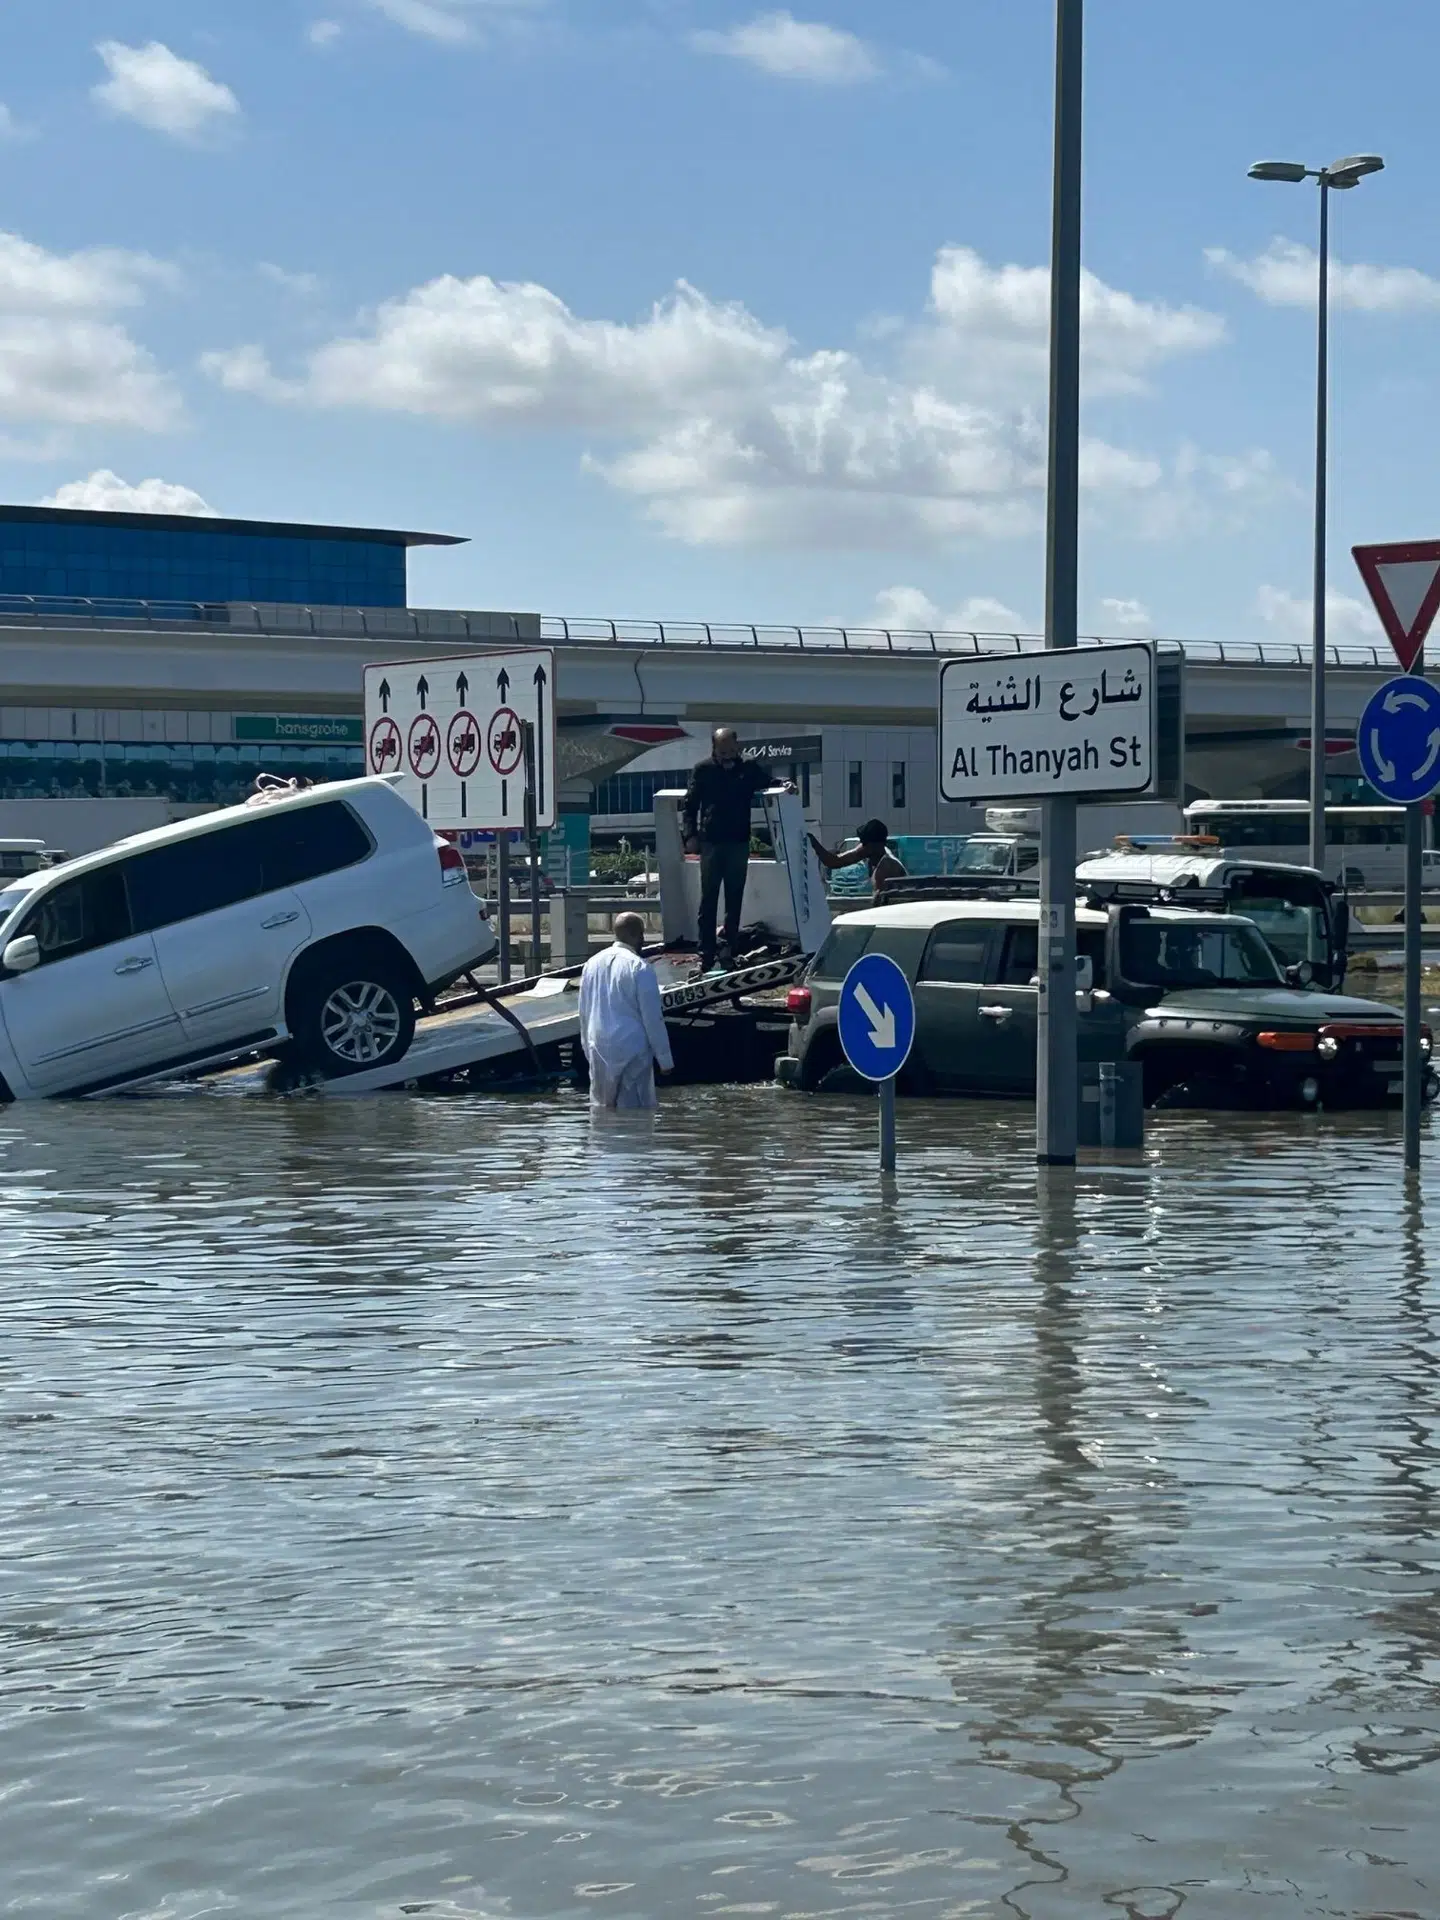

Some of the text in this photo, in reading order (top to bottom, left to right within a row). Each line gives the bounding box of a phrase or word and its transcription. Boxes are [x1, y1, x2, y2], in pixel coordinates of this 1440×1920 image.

[966, 669, 1143, 723] شارع الثنية
[275, 716, 349, 738] hansgrohe
[950, 736, 1142, 780] Al Thanyah St
